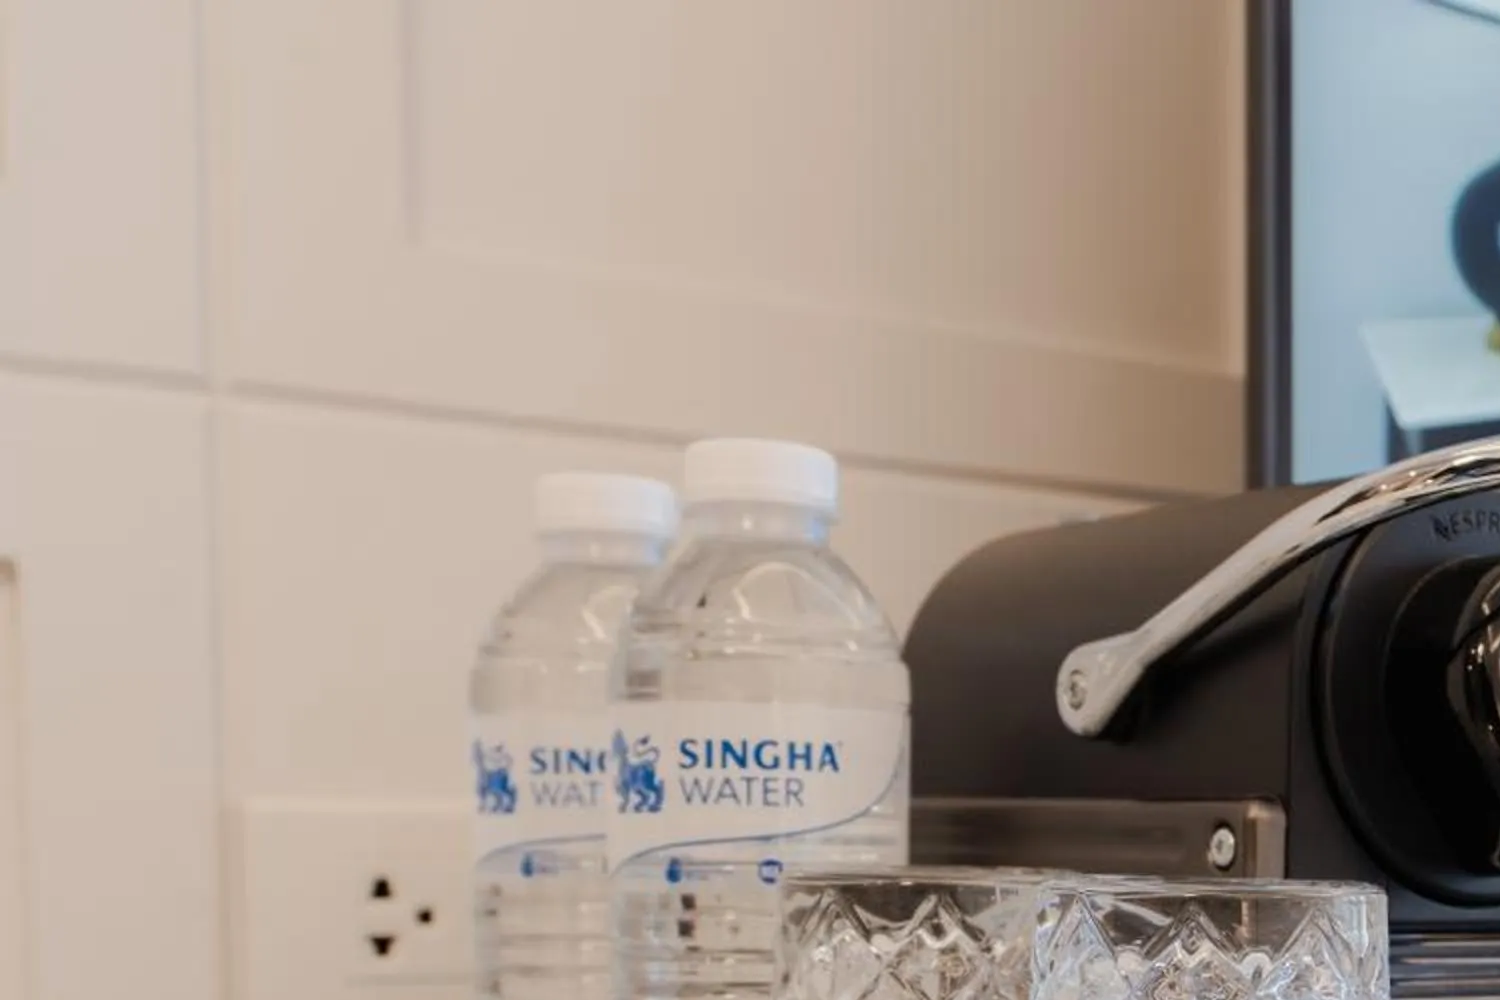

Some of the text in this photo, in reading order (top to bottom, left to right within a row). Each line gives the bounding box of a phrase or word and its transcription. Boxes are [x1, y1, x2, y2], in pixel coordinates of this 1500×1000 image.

[530, 747, 607, 774] SIN
[679, 738, 840, 773] SINGHA
[529, 780, 604, 807] WAT
[679, 776, 804, 807] WATER
